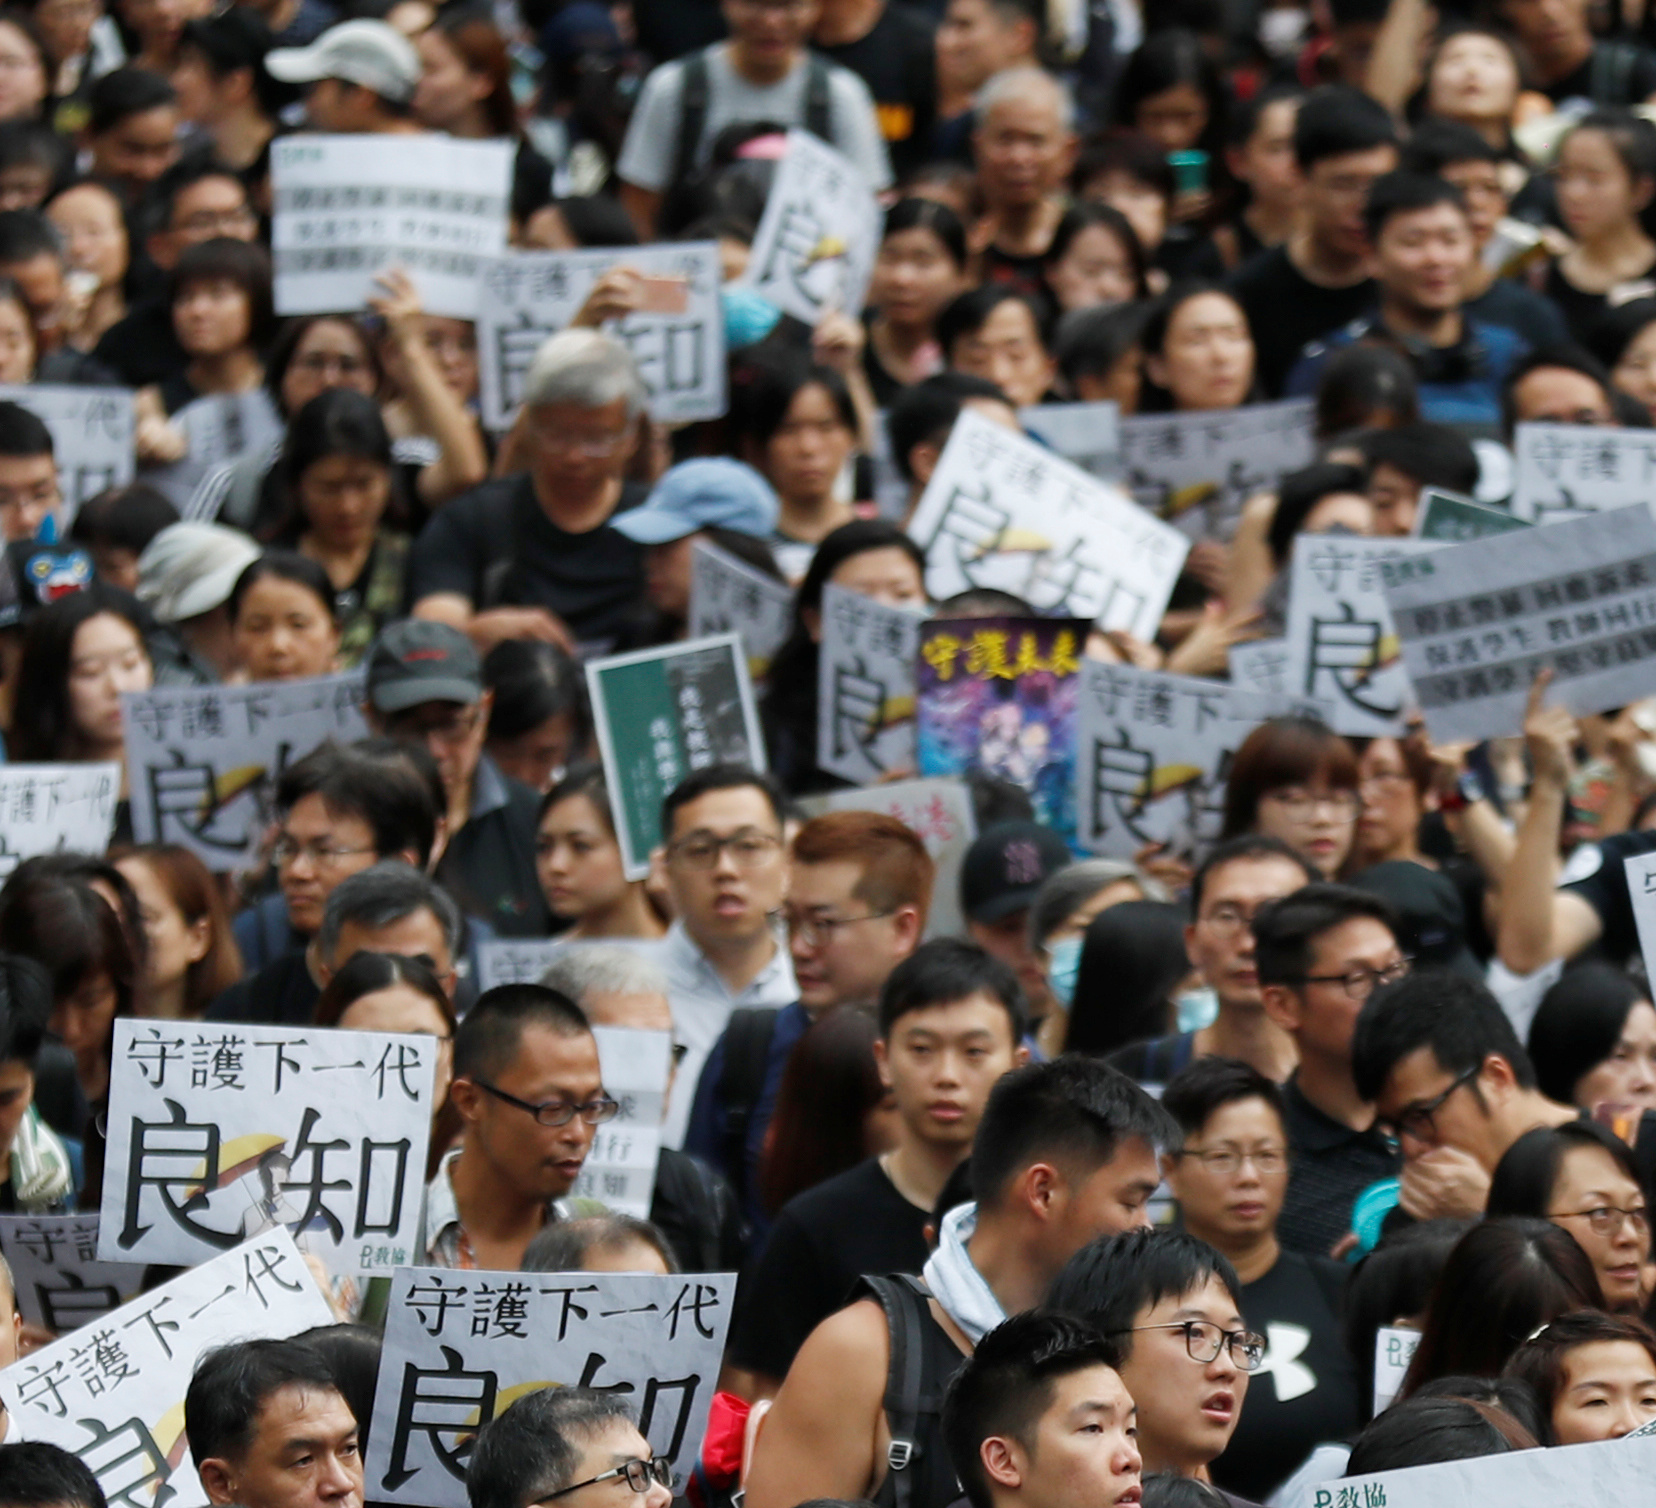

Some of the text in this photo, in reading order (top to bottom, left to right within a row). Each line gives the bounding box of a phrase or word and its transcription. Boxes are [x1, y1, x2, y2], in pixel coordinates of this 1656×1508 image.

[1307, 601, 1404, 719] 良
[125, 1028, 426, 1101] 守護下一代
[117, 1097, 414, 1252] 良知
[15, 1243, 306, 1424] 守護下一代
[402, 1273, 722, 1342] 守護下一代
